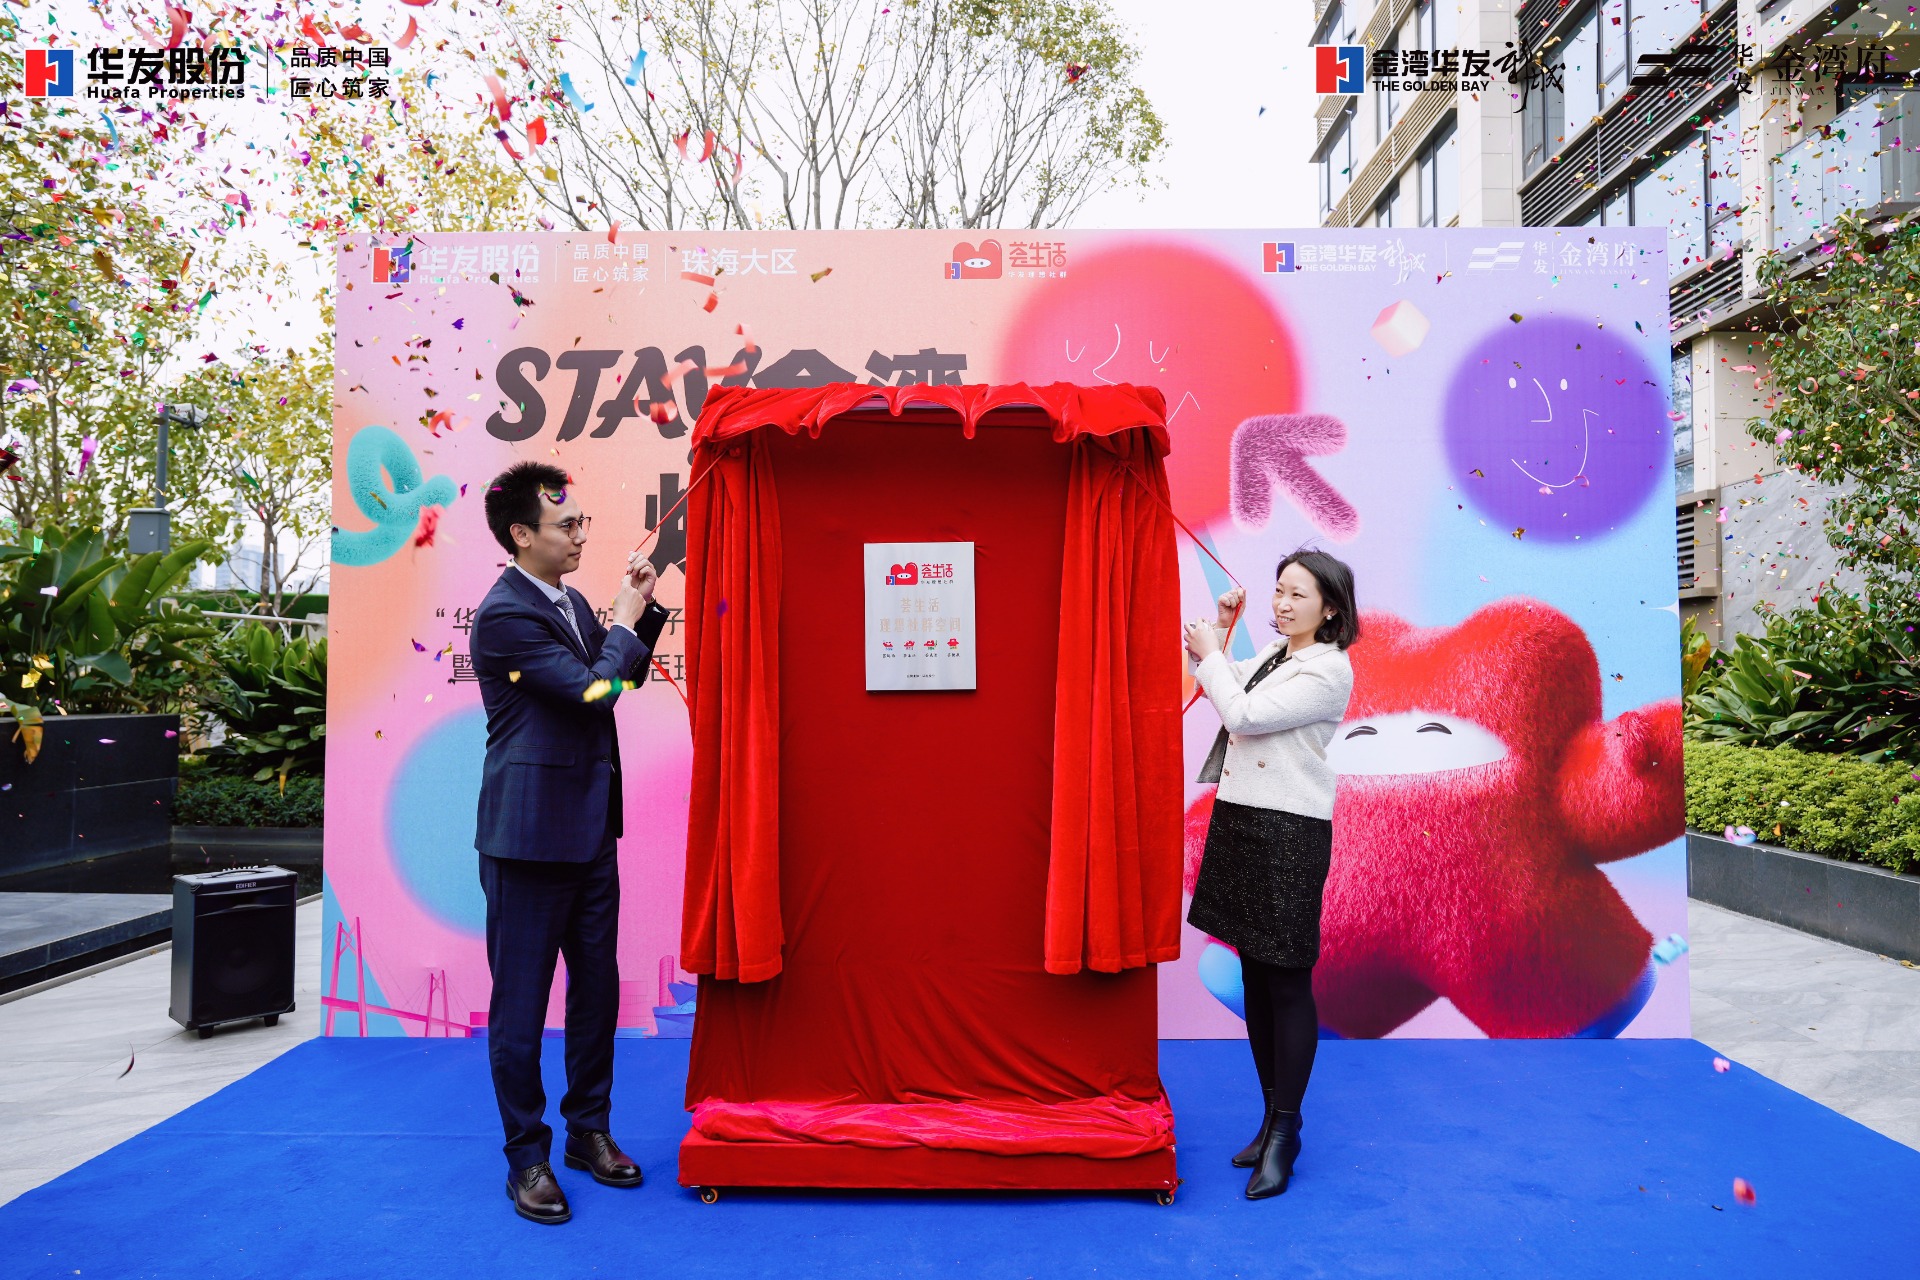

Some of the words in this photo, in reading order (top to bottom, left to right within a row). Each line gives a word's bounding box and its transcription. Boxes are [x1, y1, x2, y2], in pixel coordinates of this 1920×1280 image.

[420, 244, 540, 274] 华发股份
[574, 243, 649, 260] 品质中国
[1009, 241, 1067, 267] 荟生活
[1300, 244, 1377, 263] 金湾华发
[1533, 240, 1549, 275] 华发
[1559, 241, 1637, 267] 金湾府
[681, 247, 798, 276] 珠海大区
[1301, 264, 1319, 272] THE
[1319, 264, 1357, 272] GOLDEN
[1358, 264, 1377, 272] BAY
[466, 275, 539, 286] Proerties
[573, 266, 649, 283] 匠心筑家
[921, 563, 954, 579] 荟生活
[235, 881, 257, 889] EDIFIER
